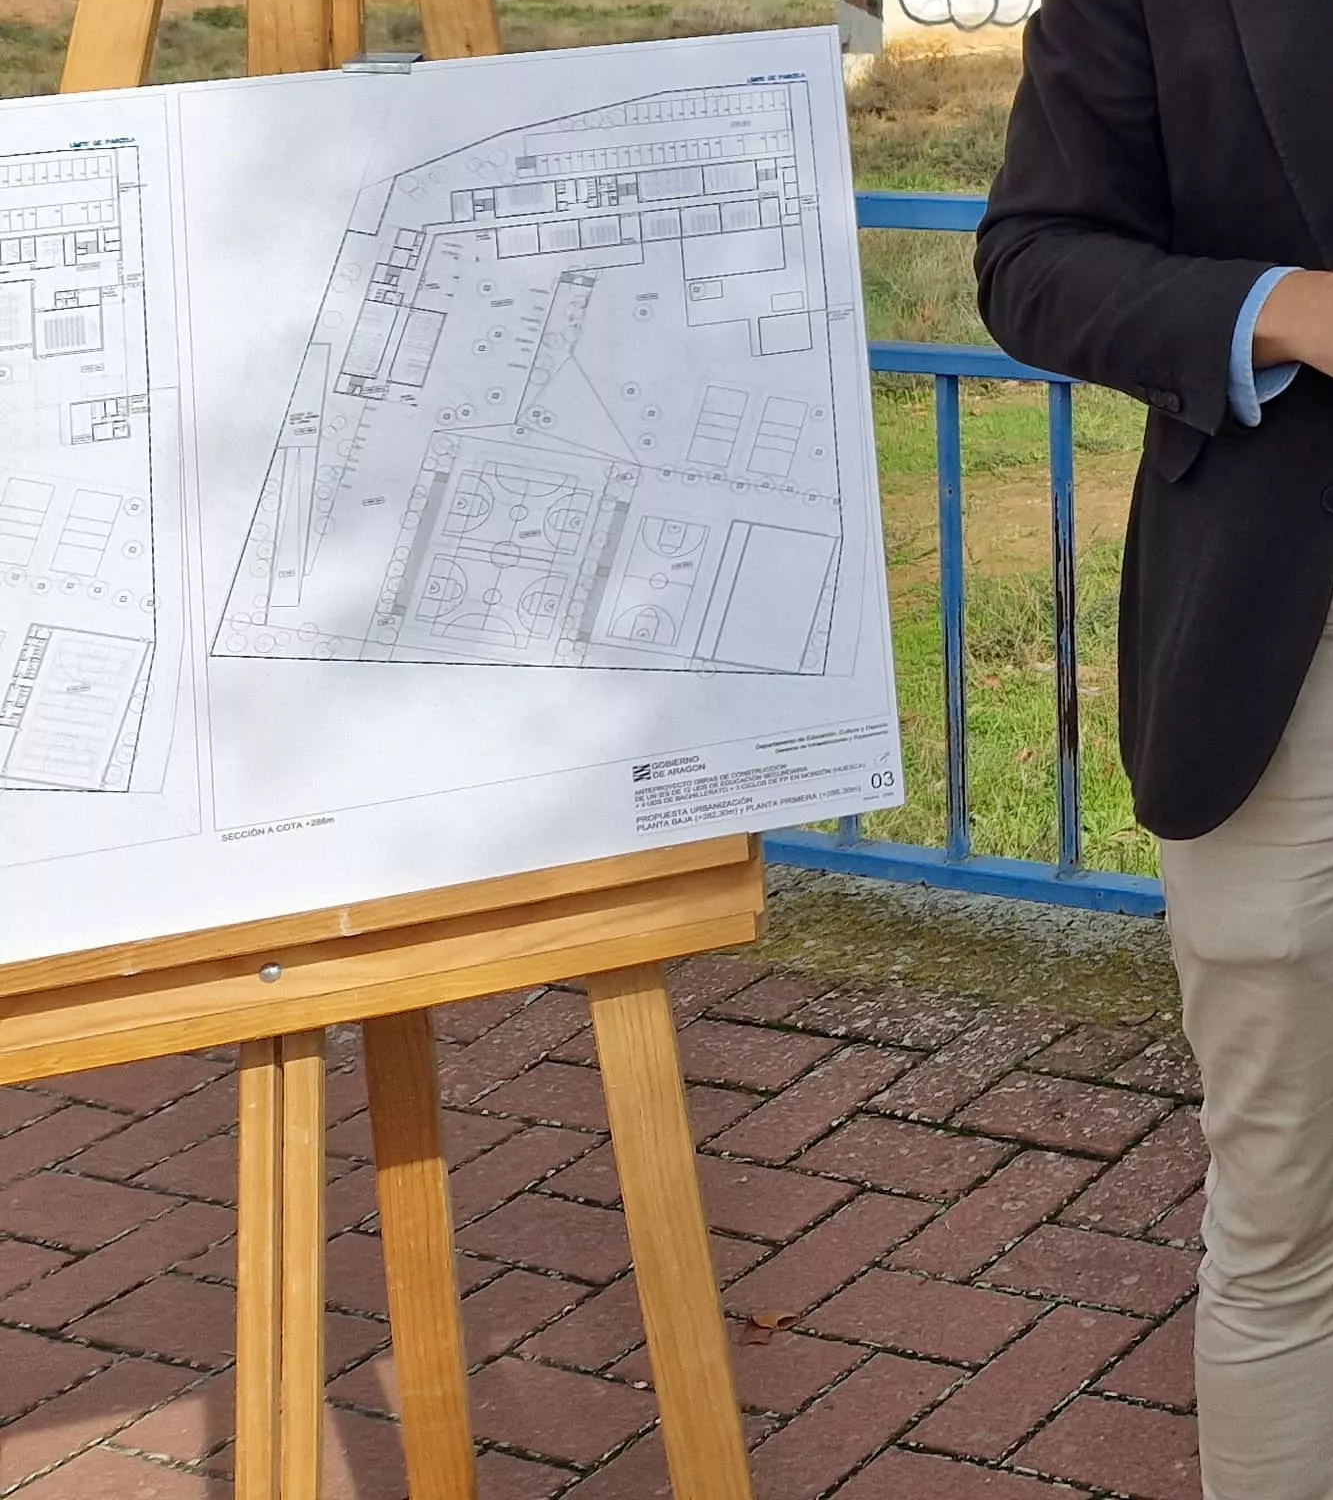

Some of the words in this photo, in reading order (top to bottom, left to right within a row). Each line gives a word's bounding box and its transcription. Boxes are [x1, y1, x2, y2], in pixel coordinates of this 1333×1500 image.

[651, 755, 700, 770] GOBIERNO
[652, 770, 666, 779] DE
[634, 781, 693, 795] ANTEPROYECTO
[693, 775, 718, 785] OBRAS
[730, 763, 787, 779] CONSTRUCCIÓN
[634, 795, 645, 803] DE
[646, 793, 657, 801] UN
[671, 789, 682, 797] DE
[720, 773, 762, 787] EDUCACIÓN
[763, 766, 808, 779] SECUNDARIA
[675, 786, 728, 802] BACHILLERATO
[740, 778, 767, 790] CICLOS
[801, 768, 832, 780] MONZÓN
[870, 770, 895, 789] 03
[636, 808, 689, 824] PROPUESTA
[690, 796, 753, 813] URBANIZACIÓN
[636, 820, 670, 833] PLANTA
[671, 815, 694, 826] BAJA
[745, 801, 778, 813] PLANTA
[779, 793, 818, 806] PRIMERA
[221, 828, 265, 842] SECCIÓN
[267, 826, 274, 835] A
[276, 821, 303, 833] COTA
